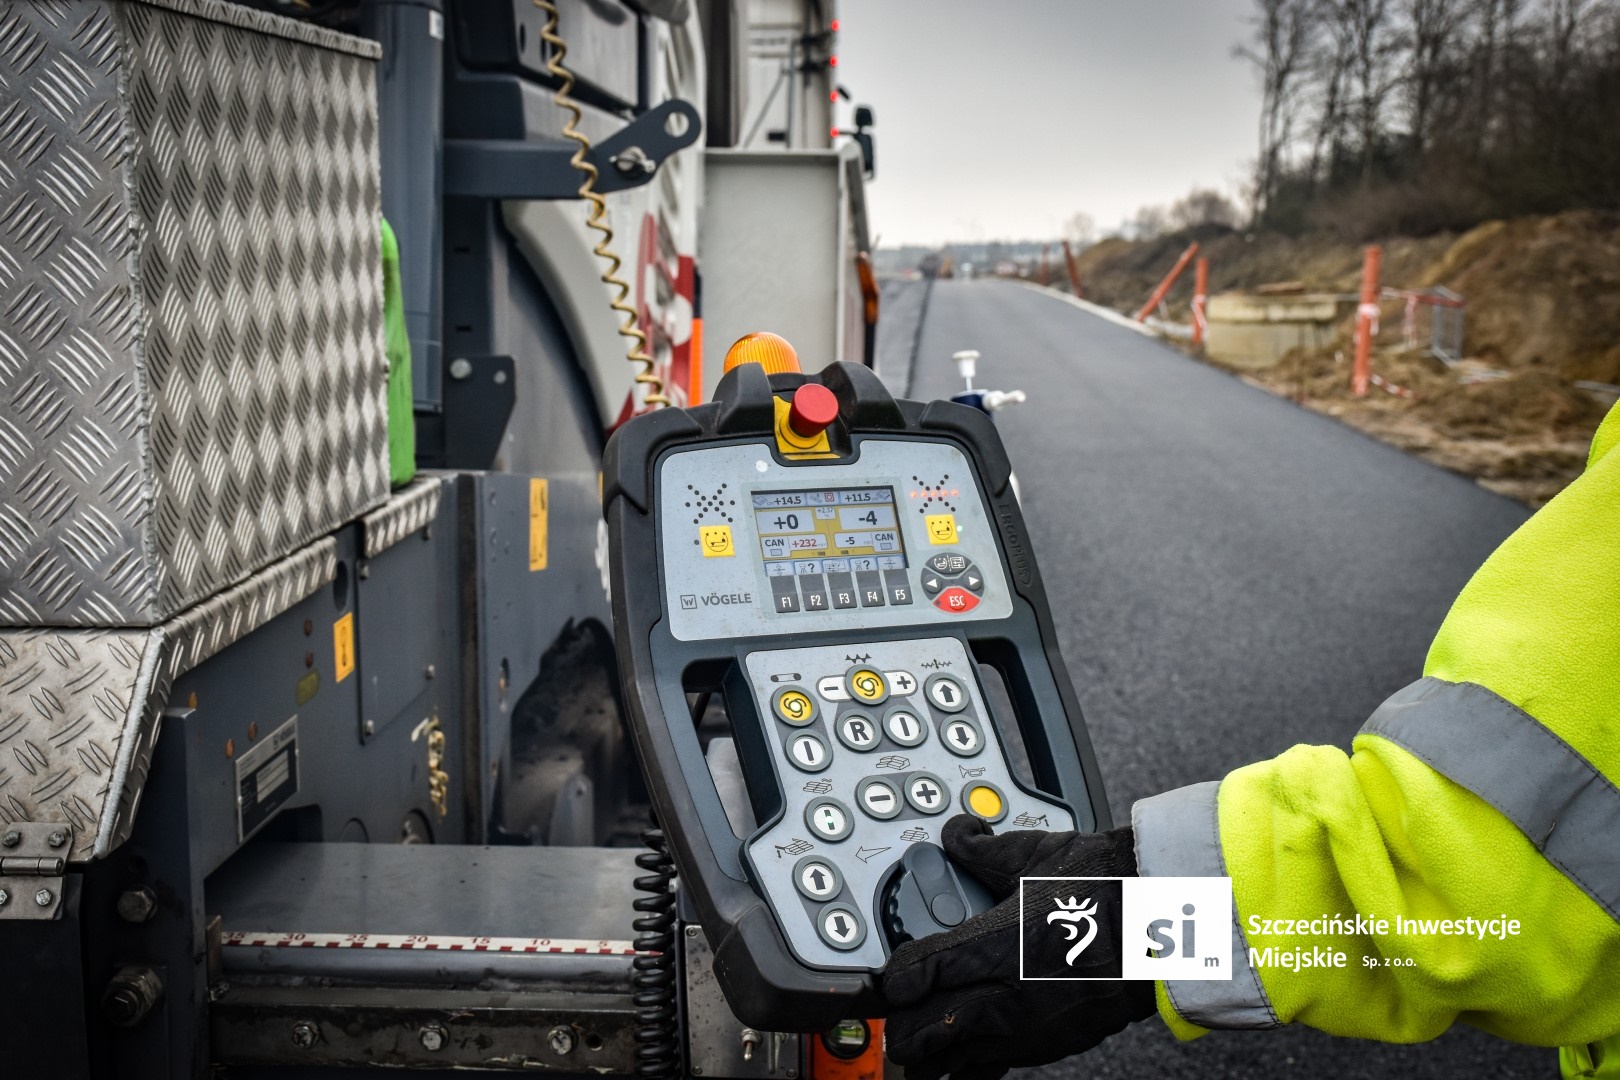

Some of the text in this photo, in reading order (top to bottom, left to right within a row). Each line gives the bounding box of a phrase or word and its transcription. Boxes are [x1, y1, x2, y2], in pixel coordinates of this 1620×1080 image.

[774, 496, 802, 506] +14.5
[845, 493, 871, 502] +11.5
[774, 514, 799, 530] +0
[858, 510, 878, 526] -4
[765, 539, 785, 547] CAN
[792, 539, 817, 548] +232
[845, 536, 855, 545] -5
[875, 533, 894, 541] CAN
[701, 592, 752, 606] VÖGELE
[839, 593, 850, 604] F3
[867, 591, 878, 602] F4
[895, 589, 906, 600] F5
[781, 597, 792, 608] F1
[810, 595, 822, 606] F2
[949, 595, 965, 607] ESC
[849, 721, 869, 742] R
[283, 933, 306, 941] 30
[345, 934, 368, 942] 25
[406, 935, 428, 943] 20
[471, 937, 490, 945] 15
[531, 938, 551, 946] 10
